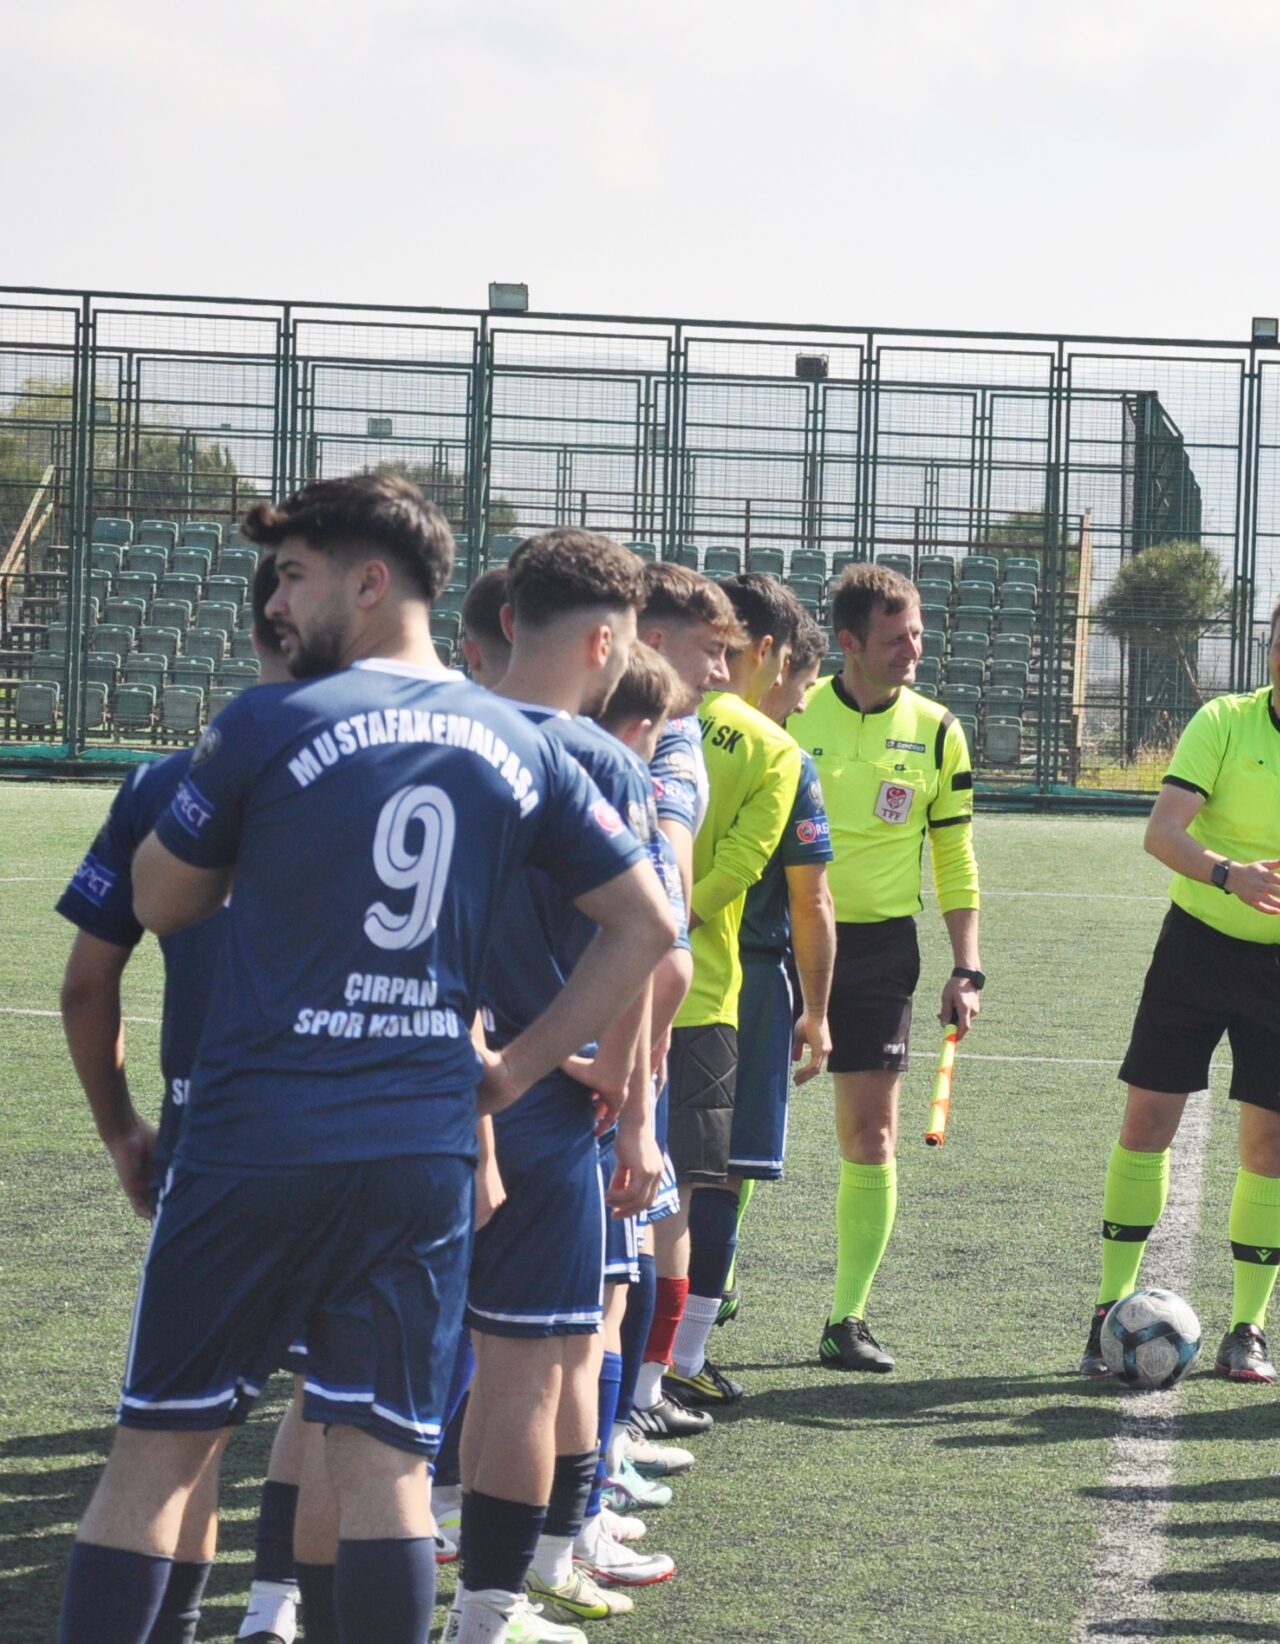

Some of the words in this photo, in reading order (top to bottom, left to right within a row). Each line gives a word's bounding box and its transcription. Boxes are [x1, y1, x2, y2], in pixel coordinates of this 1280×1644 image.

[712, 725, 744, 753] SK
[881, 807, 902, 821] TFF
[363, 783, 457, 951] 9
[343, 972, 438, 1007] ÇIRPAN
[293, 1008, 365, 1038] SPOR
